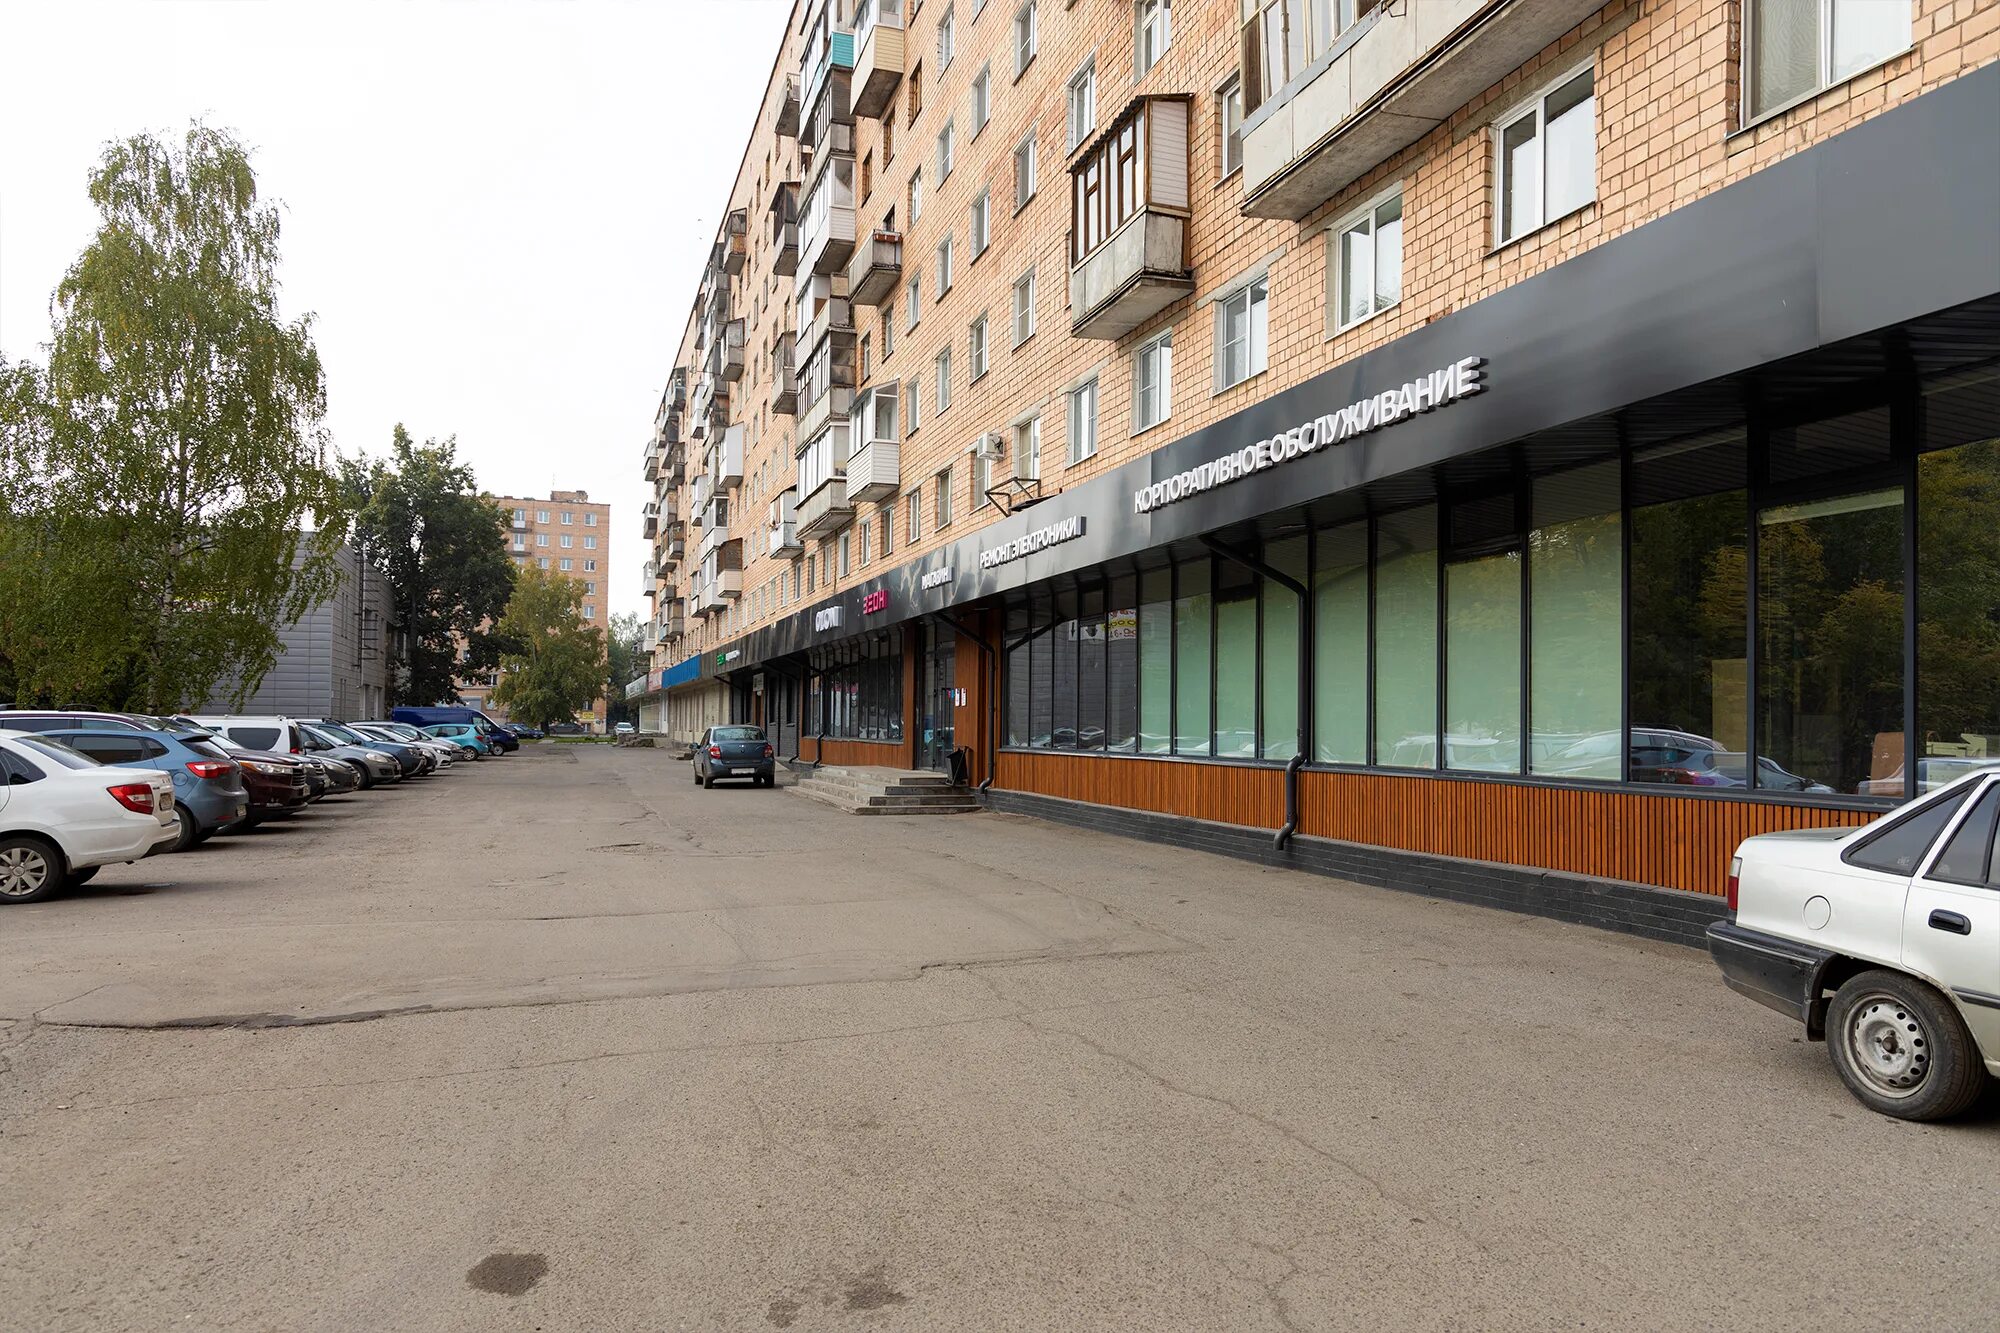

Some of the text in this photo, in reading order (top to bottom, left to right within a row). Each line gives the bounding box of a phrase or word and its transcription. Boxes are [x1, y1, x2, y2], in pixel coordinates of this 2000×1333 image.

[1134, 356, 1481, 513] КОРПОРАТИВНОЕ ОБСЛУЖИВАНИЕ
[980, 515, 1081, 569] РЕМОНТ ЭЛЕКТРОНИКИ
